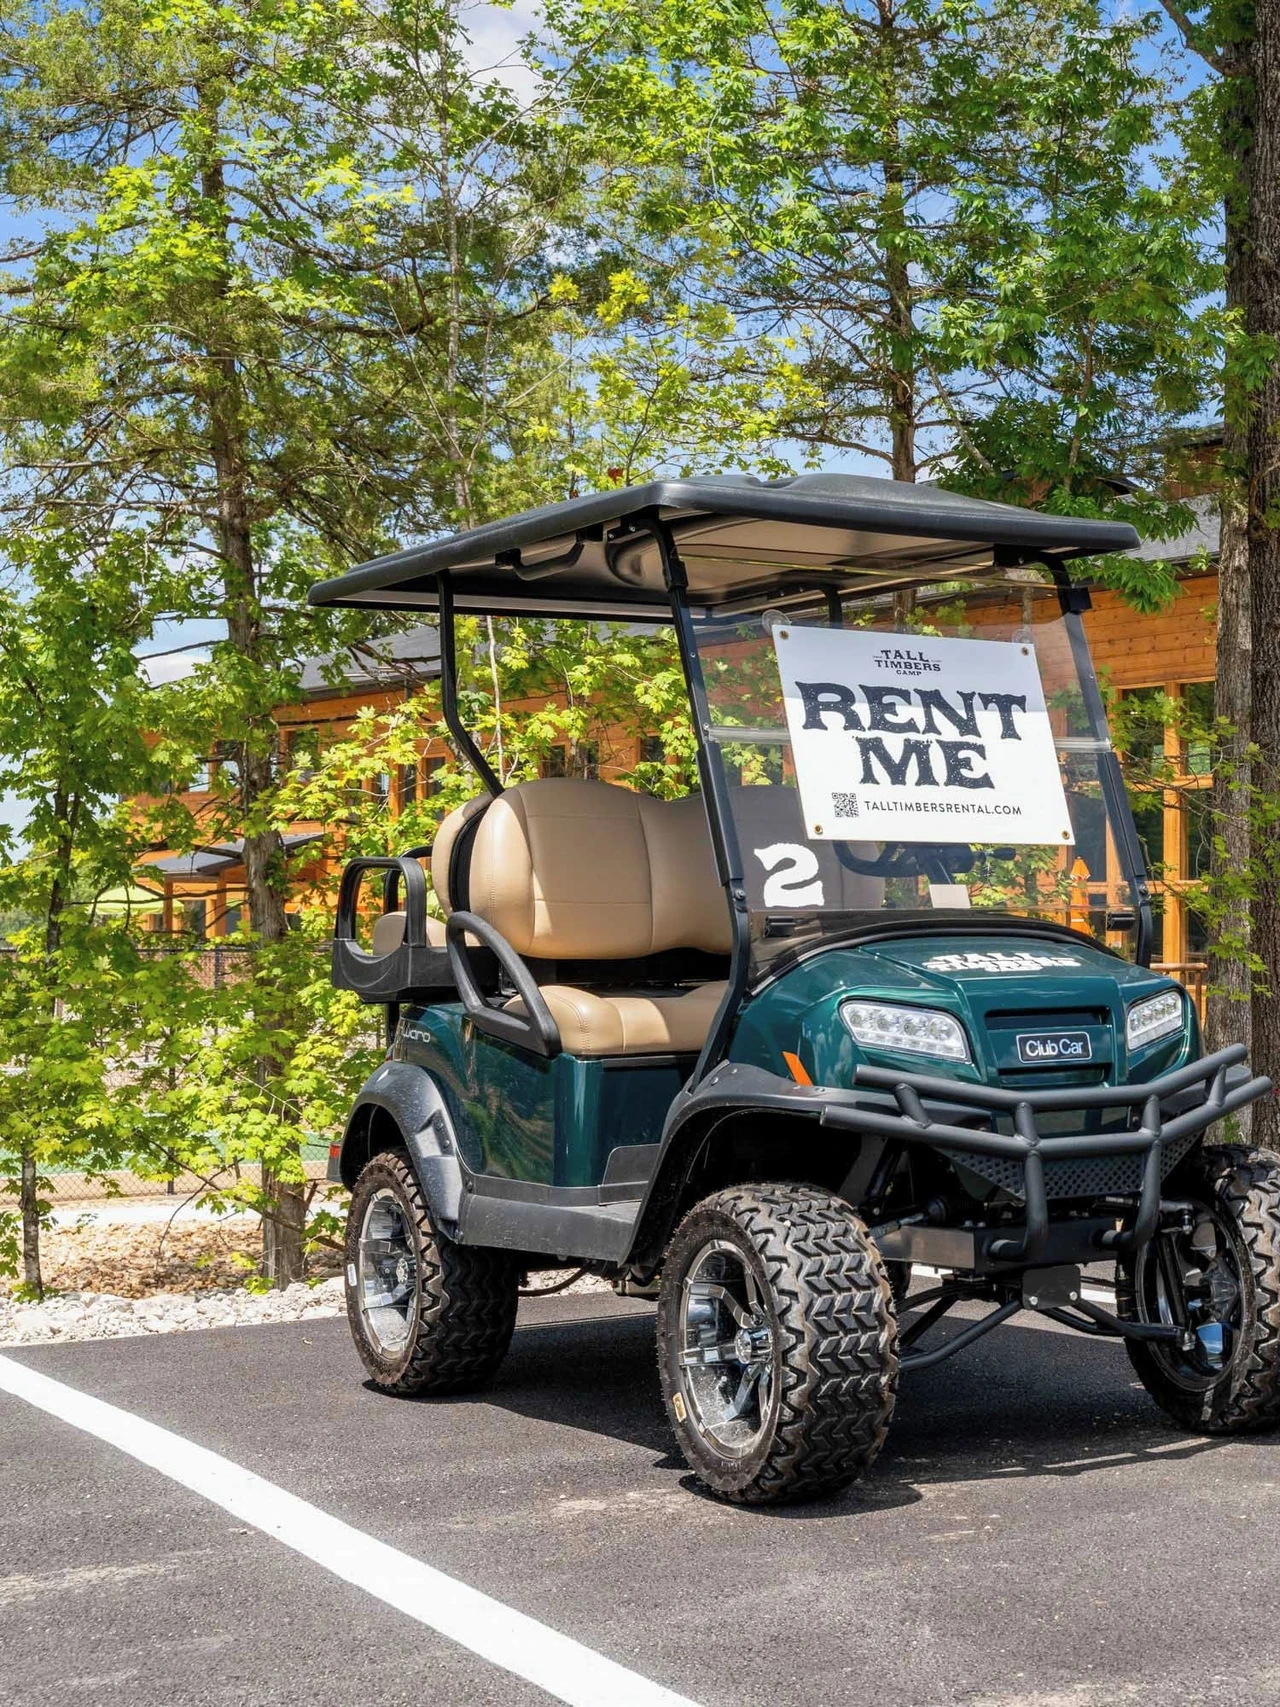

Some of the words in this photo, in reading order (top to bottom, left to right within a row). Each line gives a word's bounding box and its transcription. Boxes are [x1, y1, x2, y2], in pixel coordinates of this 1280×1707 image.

[880, 649, 930, 663] TALL
[874, 659, 941, 672] TIMBERS
[794, 681, 1027, 741] RENT
[855, 737, 995, 789] ME
[864, 800, 1023, 816] TALLTIMBERSRENTAL.COM
[753, 843, 825, 908] 2
[1026, 1040, 1058, 1056] Club
[1059, 1038, 1083, 1054] Car
